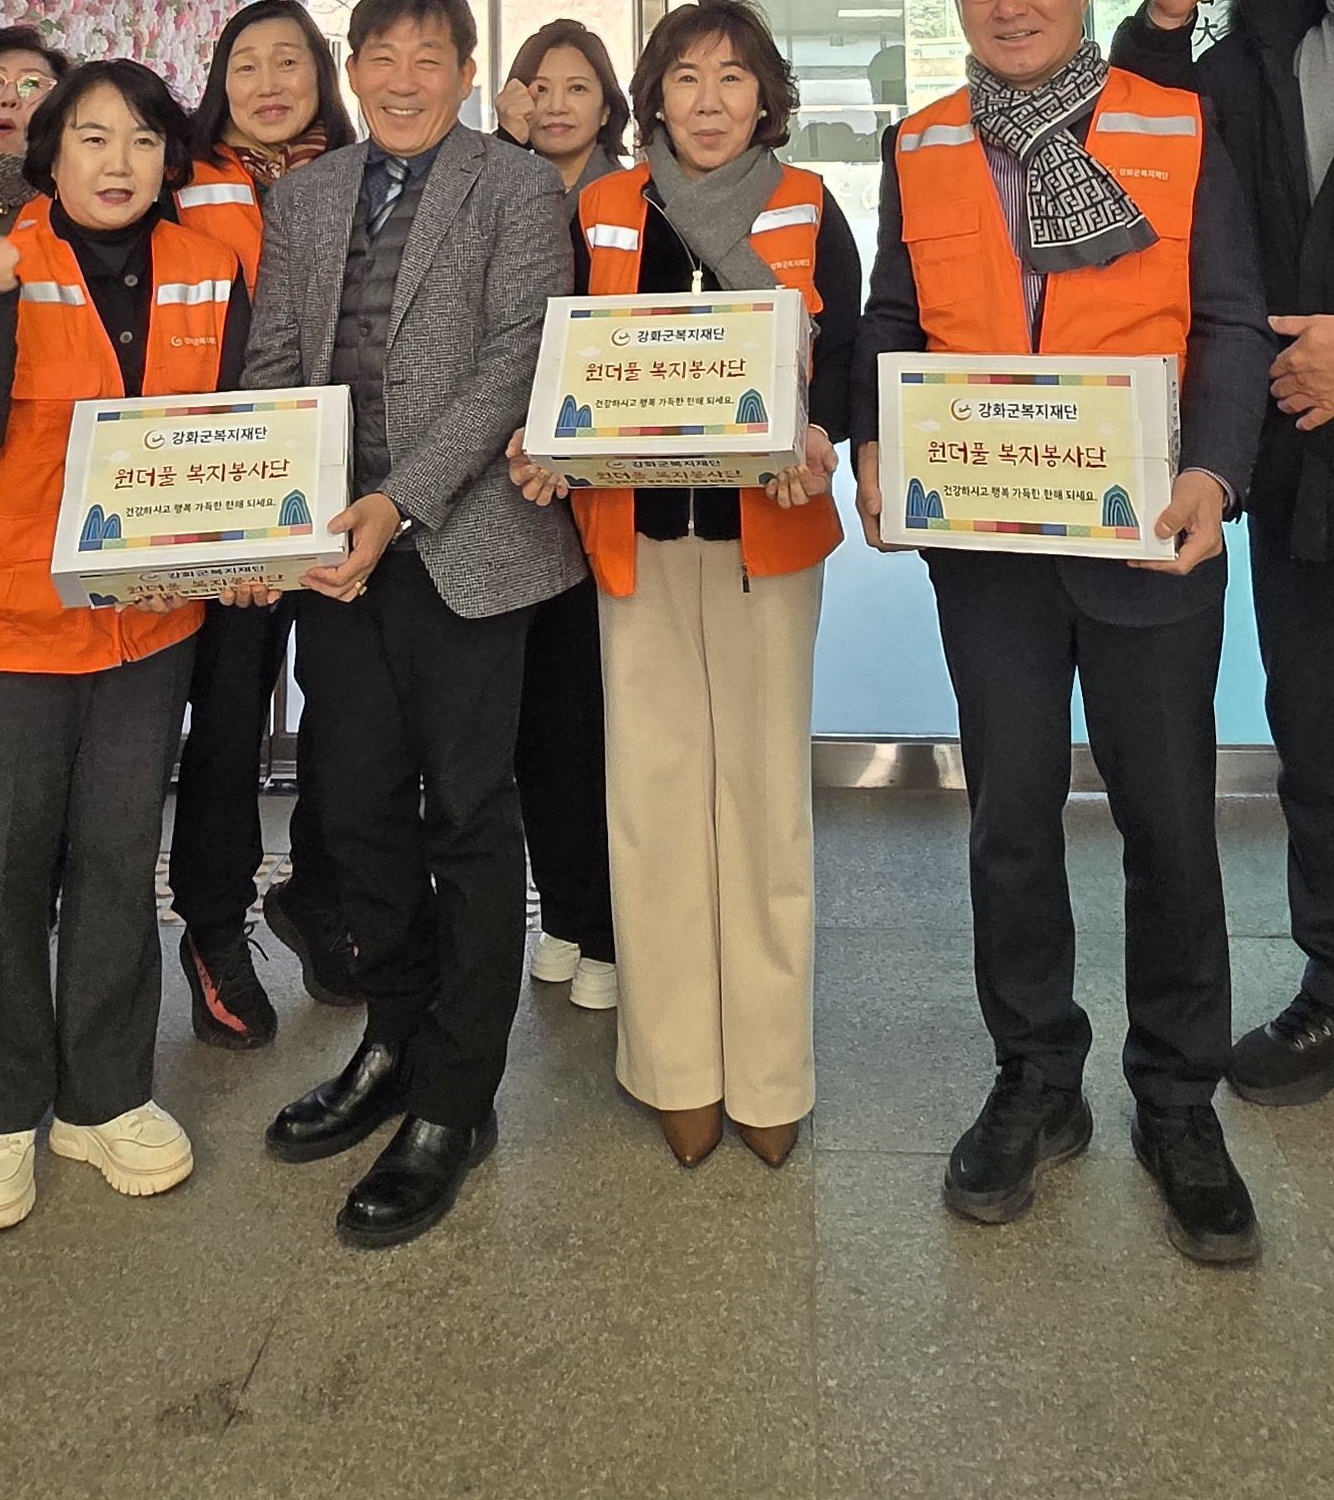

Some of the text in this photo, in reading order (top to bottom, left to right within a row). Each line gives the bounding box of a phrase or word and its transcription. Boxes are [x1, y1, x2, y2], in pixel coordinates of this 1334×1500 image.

[636, 327, 726, 342] 강화군복지재단
[585, 357, 747, 382] 원더풀 복지봉사단
[978, 402, 1078, 420] 강화군복지재단
[172, 426, 268, 445] 강화군복지재단
[927, 441, 1107, 469] 원더풀 복지봉사단
[113, 458, 291, 490] 원더풀 복지봉사단
